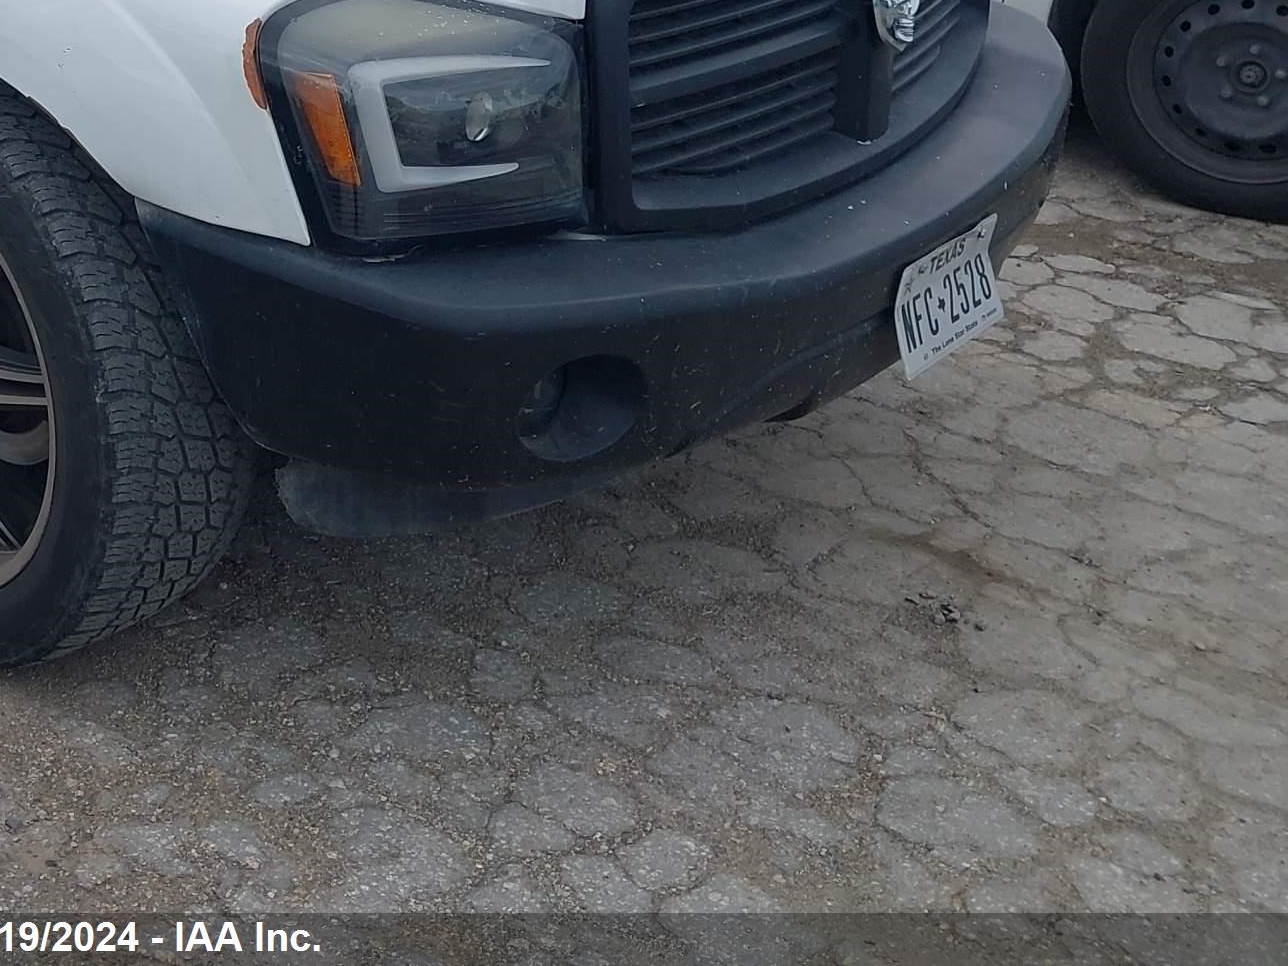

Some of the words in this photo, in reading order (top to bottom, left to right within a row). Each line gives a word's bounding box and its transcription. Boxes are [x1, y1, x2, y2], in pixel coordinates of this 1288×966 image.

[930, 238, 965, 274] TEXAS
[931, 344, 942, 355] The
[942, 335, 954, 348] Lone
